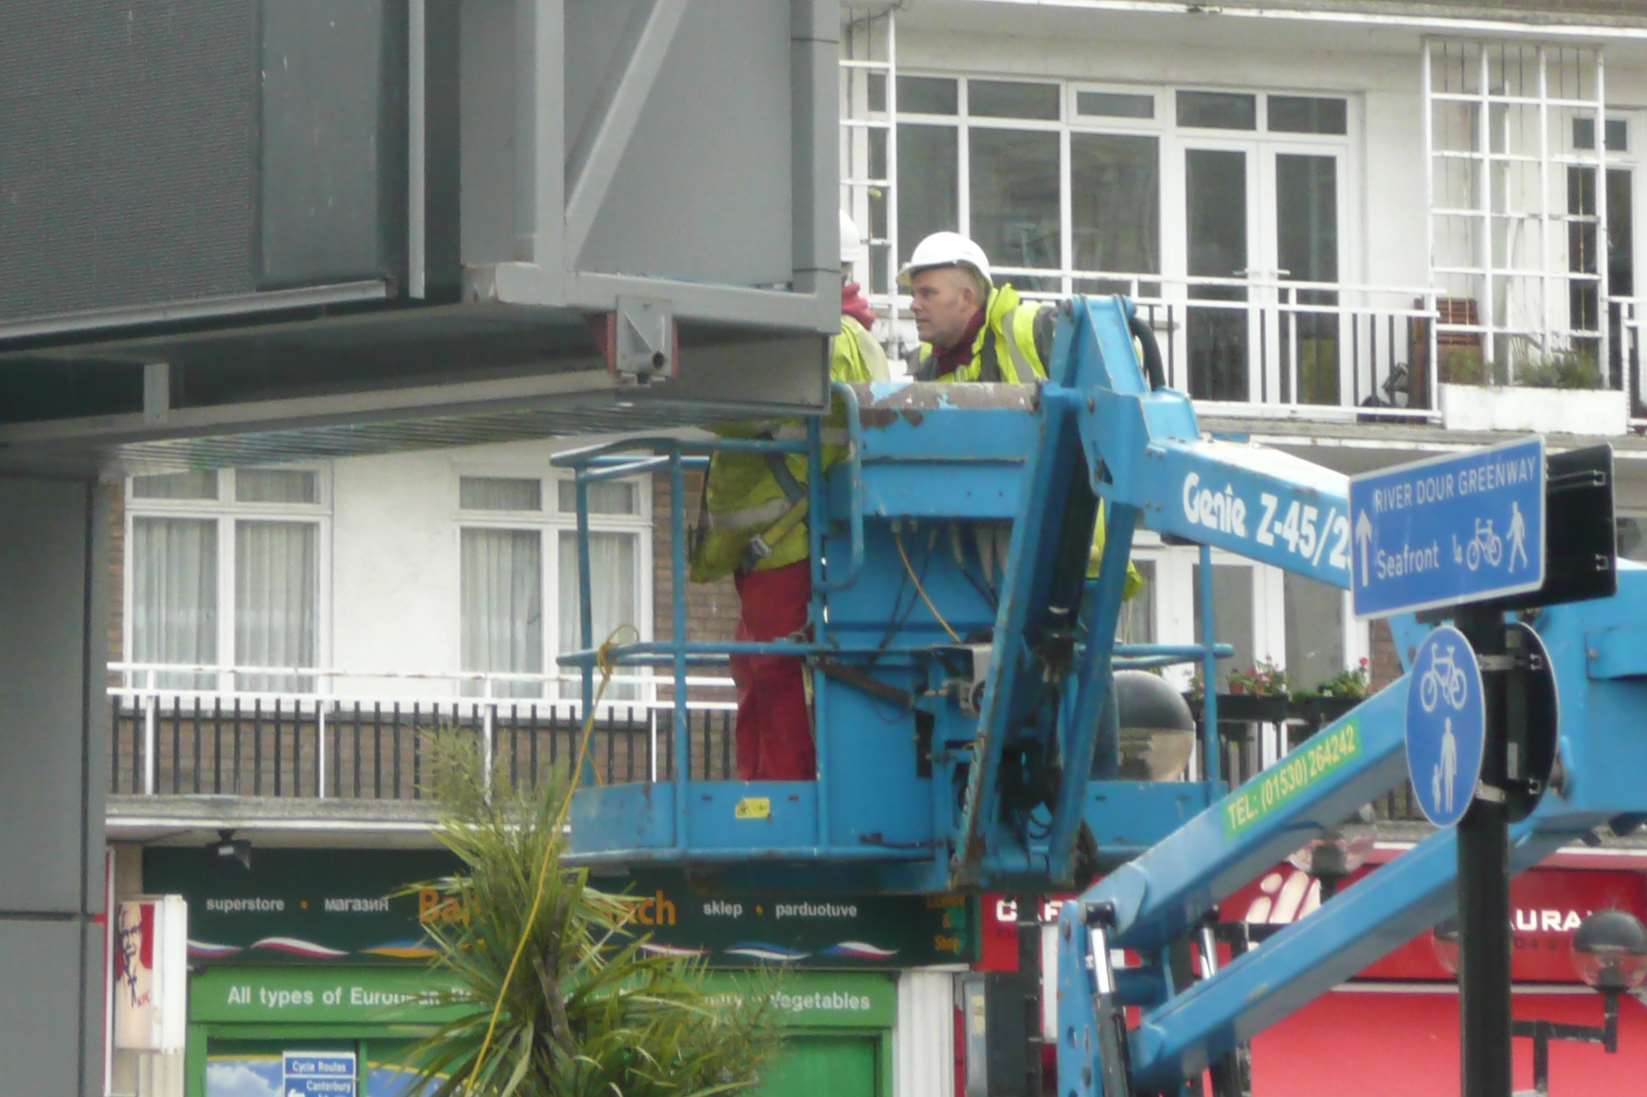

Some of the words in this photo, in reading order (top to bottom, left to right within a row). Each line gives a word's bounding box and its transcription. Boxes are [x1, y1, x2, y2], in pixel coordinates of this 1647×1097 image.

[1374, 483, 1412, 512] RIVER
[1417, 474, 1454, 504] DOUR
[1458, 456, 1536, 495] GREENWAY
[1183, 471, 1247, 538] Genie
[1256, 492, 1350, 571] Z-45/2
[1376, 540, 1440, 579] Seafront
[1261, 755, 1308, 811] (01530)
[1310, 724, 1355, 777] 264242
[206, 898, 285, 914] superstore
[324, 897, 389, 912] магазин
[703, 901, 743, 919] sklep
[776, 902, 857, 919] parduotuve
[227, 986, 251, 1004] All
[260, 986, 314, 1008] types
[322, 985, 343, 1005] of
